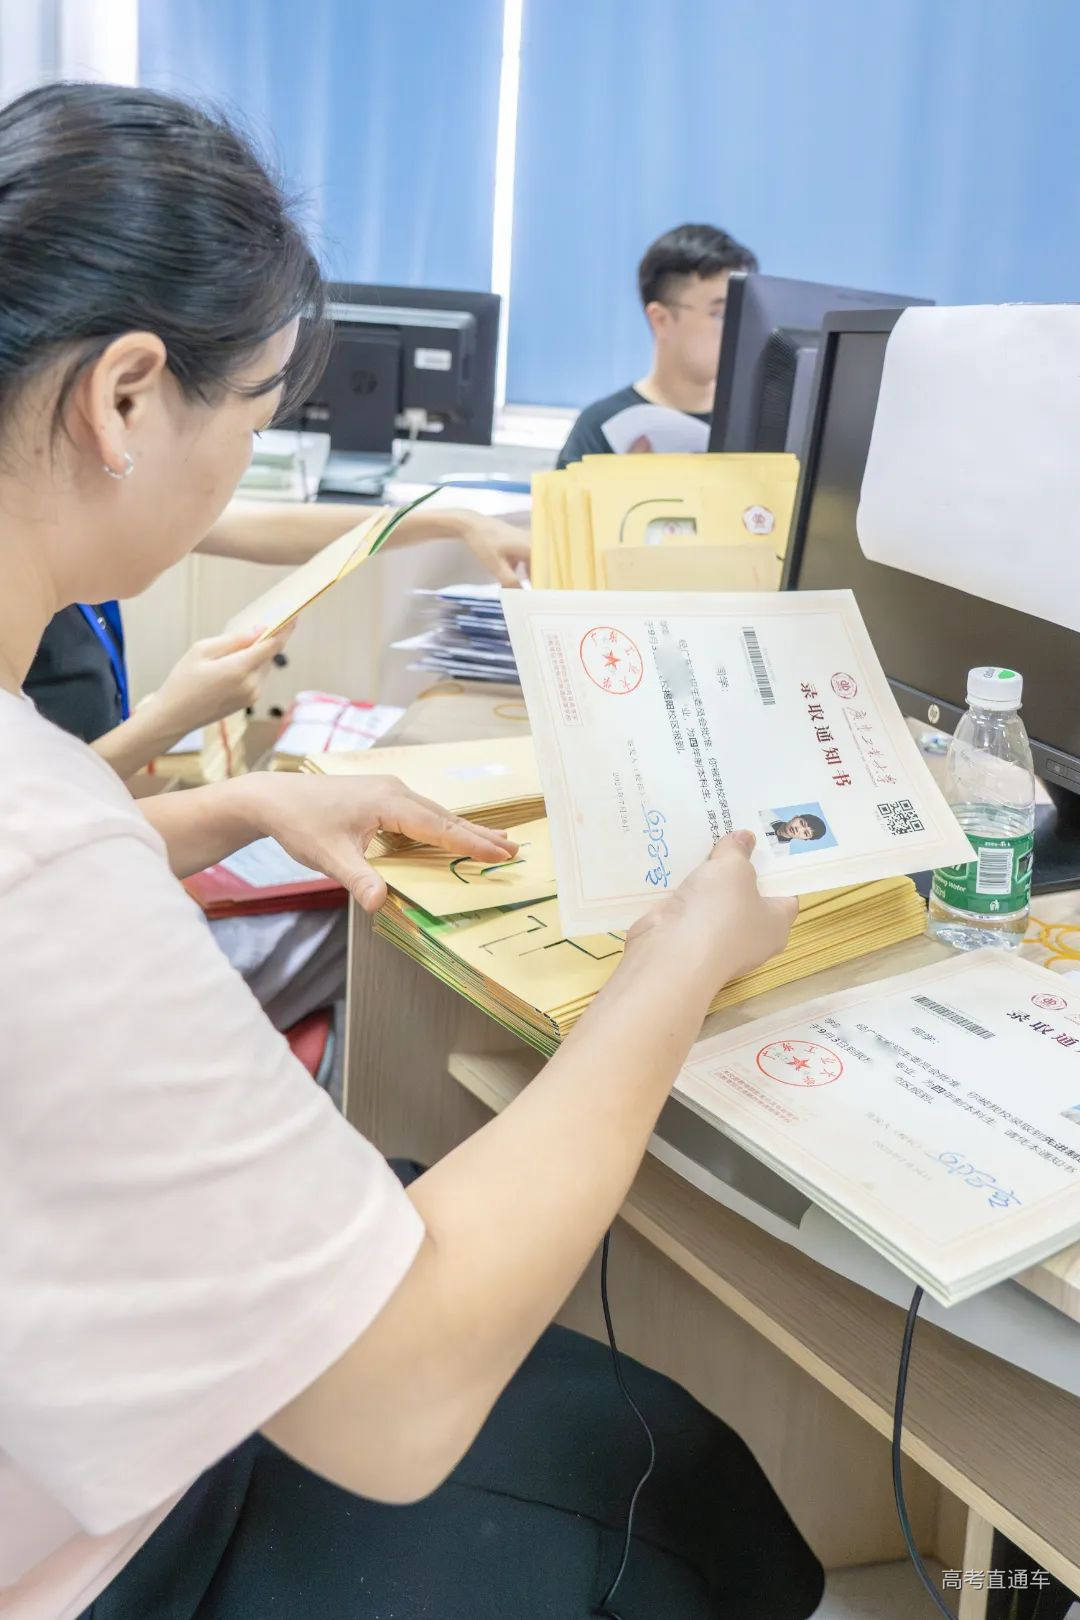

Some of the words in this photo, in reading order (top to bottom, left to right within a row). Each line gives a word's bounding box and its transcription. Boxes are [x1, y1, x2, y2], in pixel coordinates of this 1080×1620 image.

[800, 681, 852, 787] 录取通知书
[1006, 1009, 1080, 1053] 录取通
